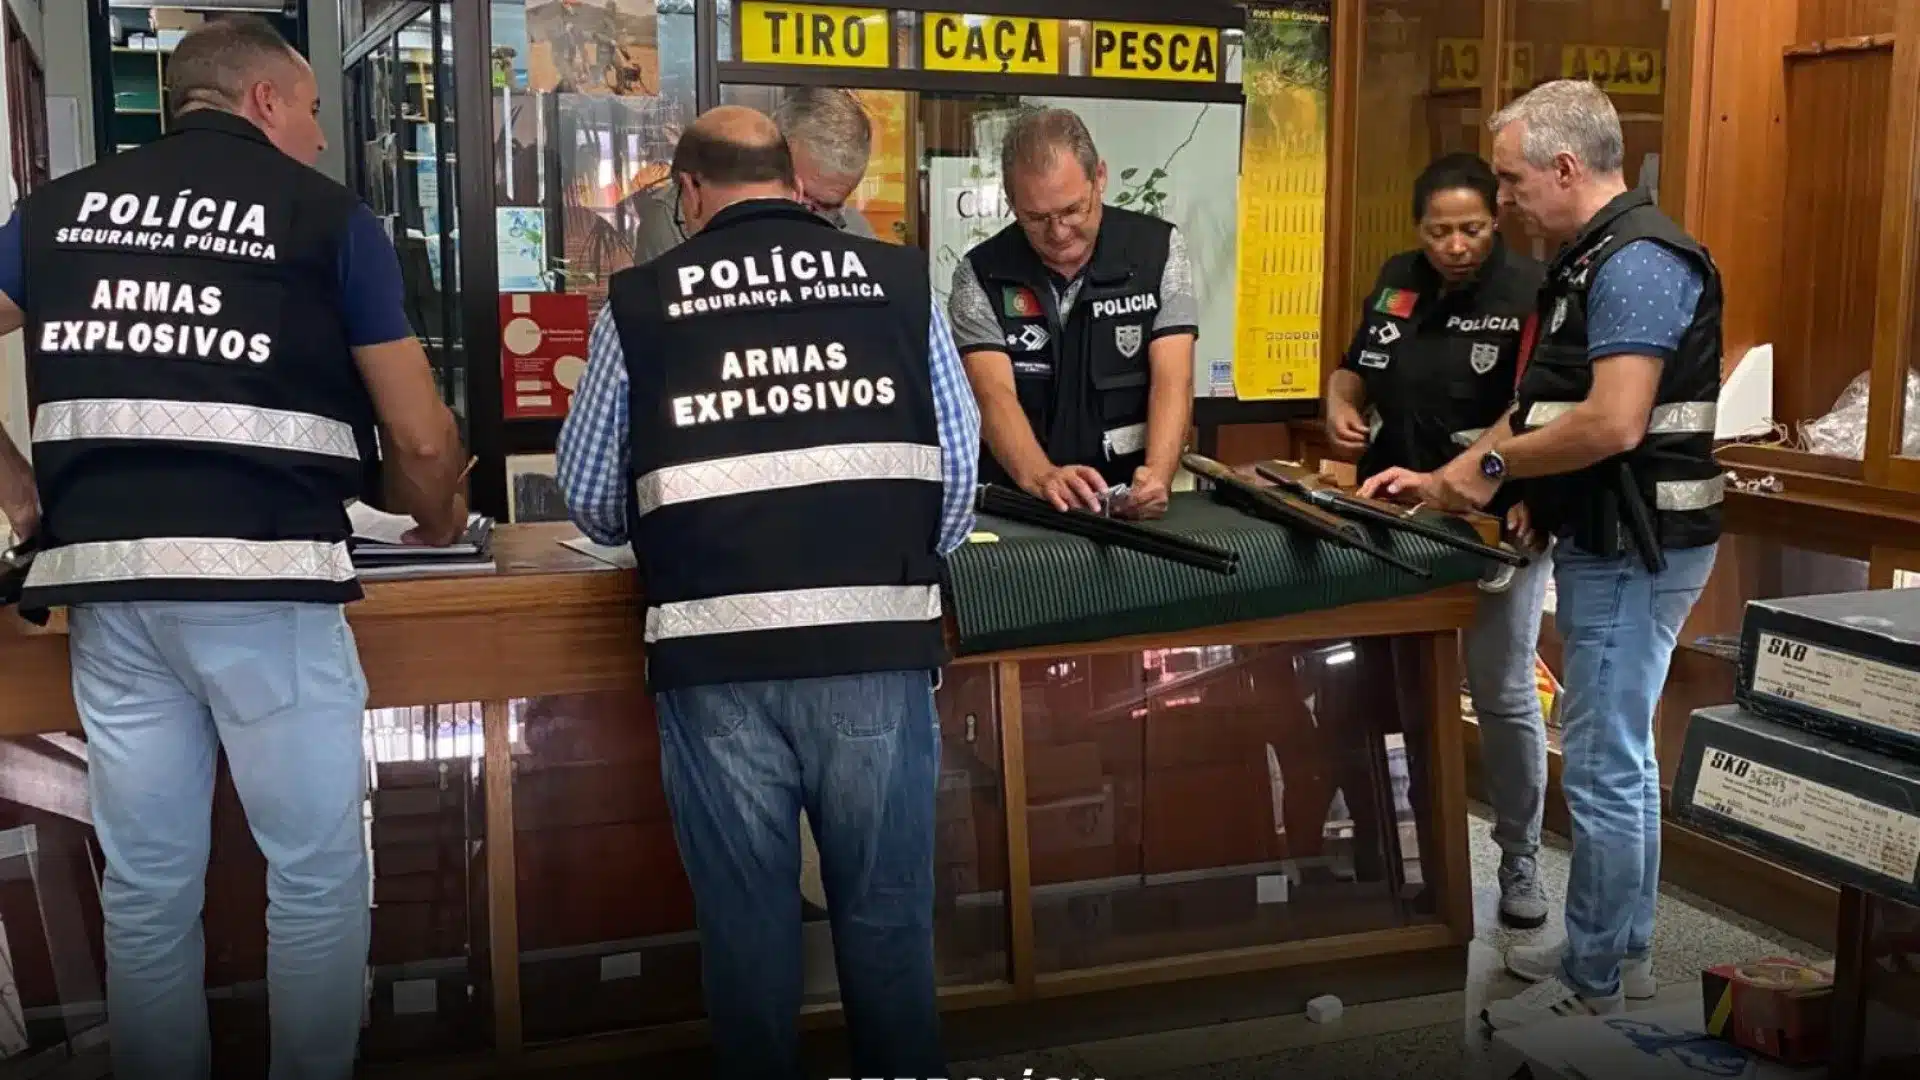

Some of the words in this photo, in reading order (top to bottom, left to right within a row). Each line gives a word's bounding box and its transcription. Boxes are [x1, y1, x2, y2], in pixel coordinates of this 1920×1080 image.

[763, 11, 867, 58] TIRO
[935, 17, 1046, 73] CAÇA
[1094, 29, 1216, 74] PESCA
[77, 188, 265, 237] POLÍCIA
[56, 227, 175, 250] SEGURANÇA
[183, 232, 277, 260] PÚBLICA
[677, 245, 868, 296] POLÍCIA
[91, 278, 223, 317] ARMAS
[668, 288, 793, 318] SEGURANÇA
[800, 280, 885, 301] PÚBLICA
[40, 320, 272, 363] EXPLOSIVOS
[721, 342, 848, 382] ARMAS
[672, 376, 896, 428] EXPLOSIVOS
[1767, 637, 1808, 663] SKB
[1709, 751, 1751, 778] SKB
